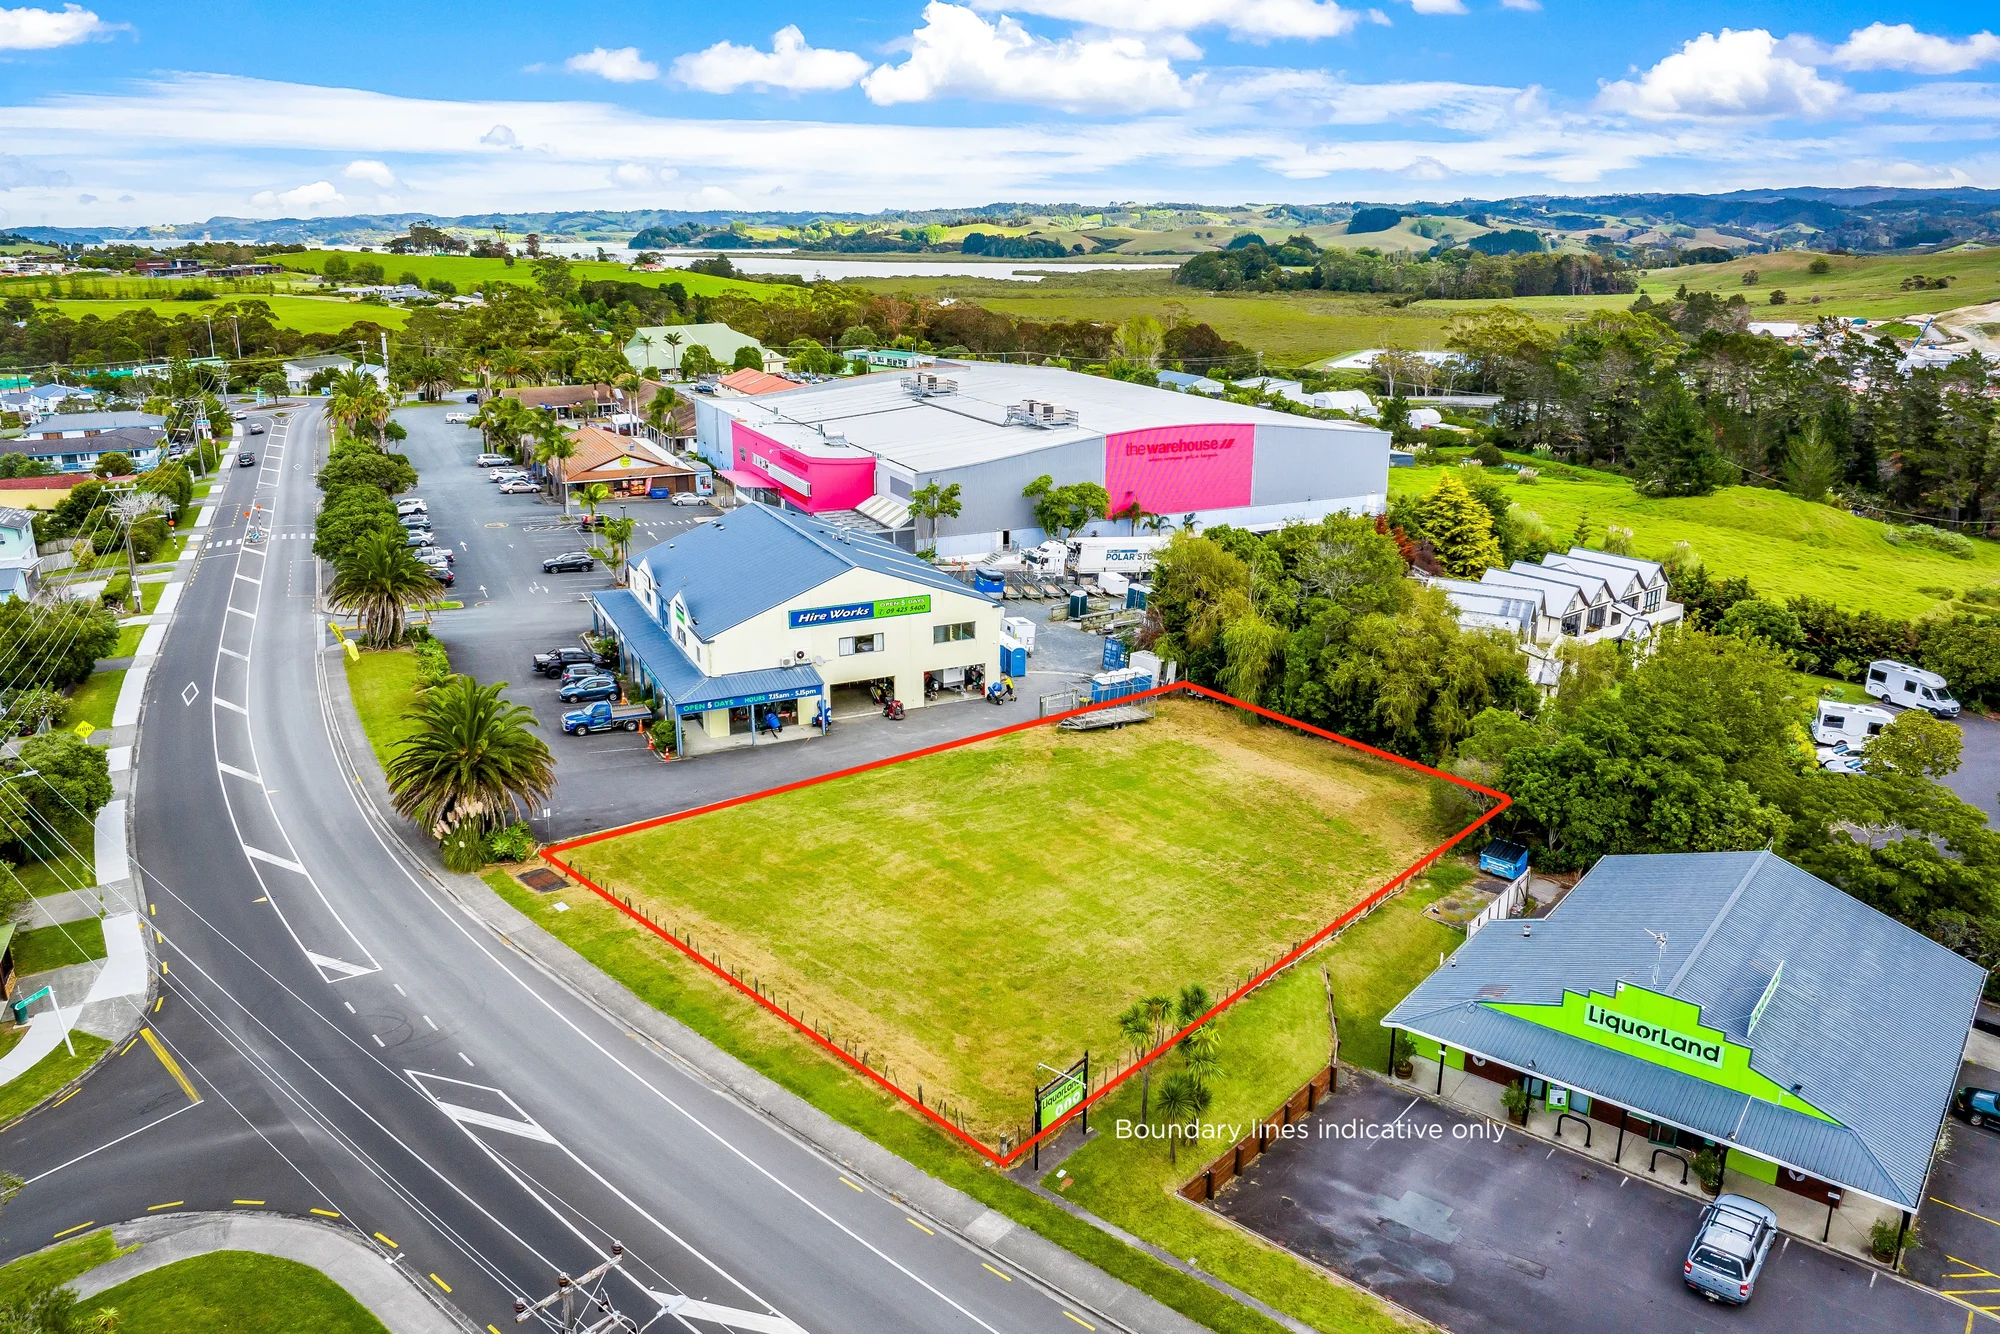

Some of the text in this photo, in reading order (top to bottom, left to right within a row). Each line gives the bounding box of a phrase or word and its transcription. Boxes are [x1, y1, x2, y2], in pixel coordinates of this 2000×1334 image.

[1106, 553, 1135, 561] POLAR
[798, 606, 870, 623] Hire Works
[683, 699, 734, 712] OPEN 5 DAYS
[744, 695, 766, 704] HOURS
[1589, 1005, 1720, 1063] LiquorLand
[1042, 1074, 1081, 1110] LiquorLand
